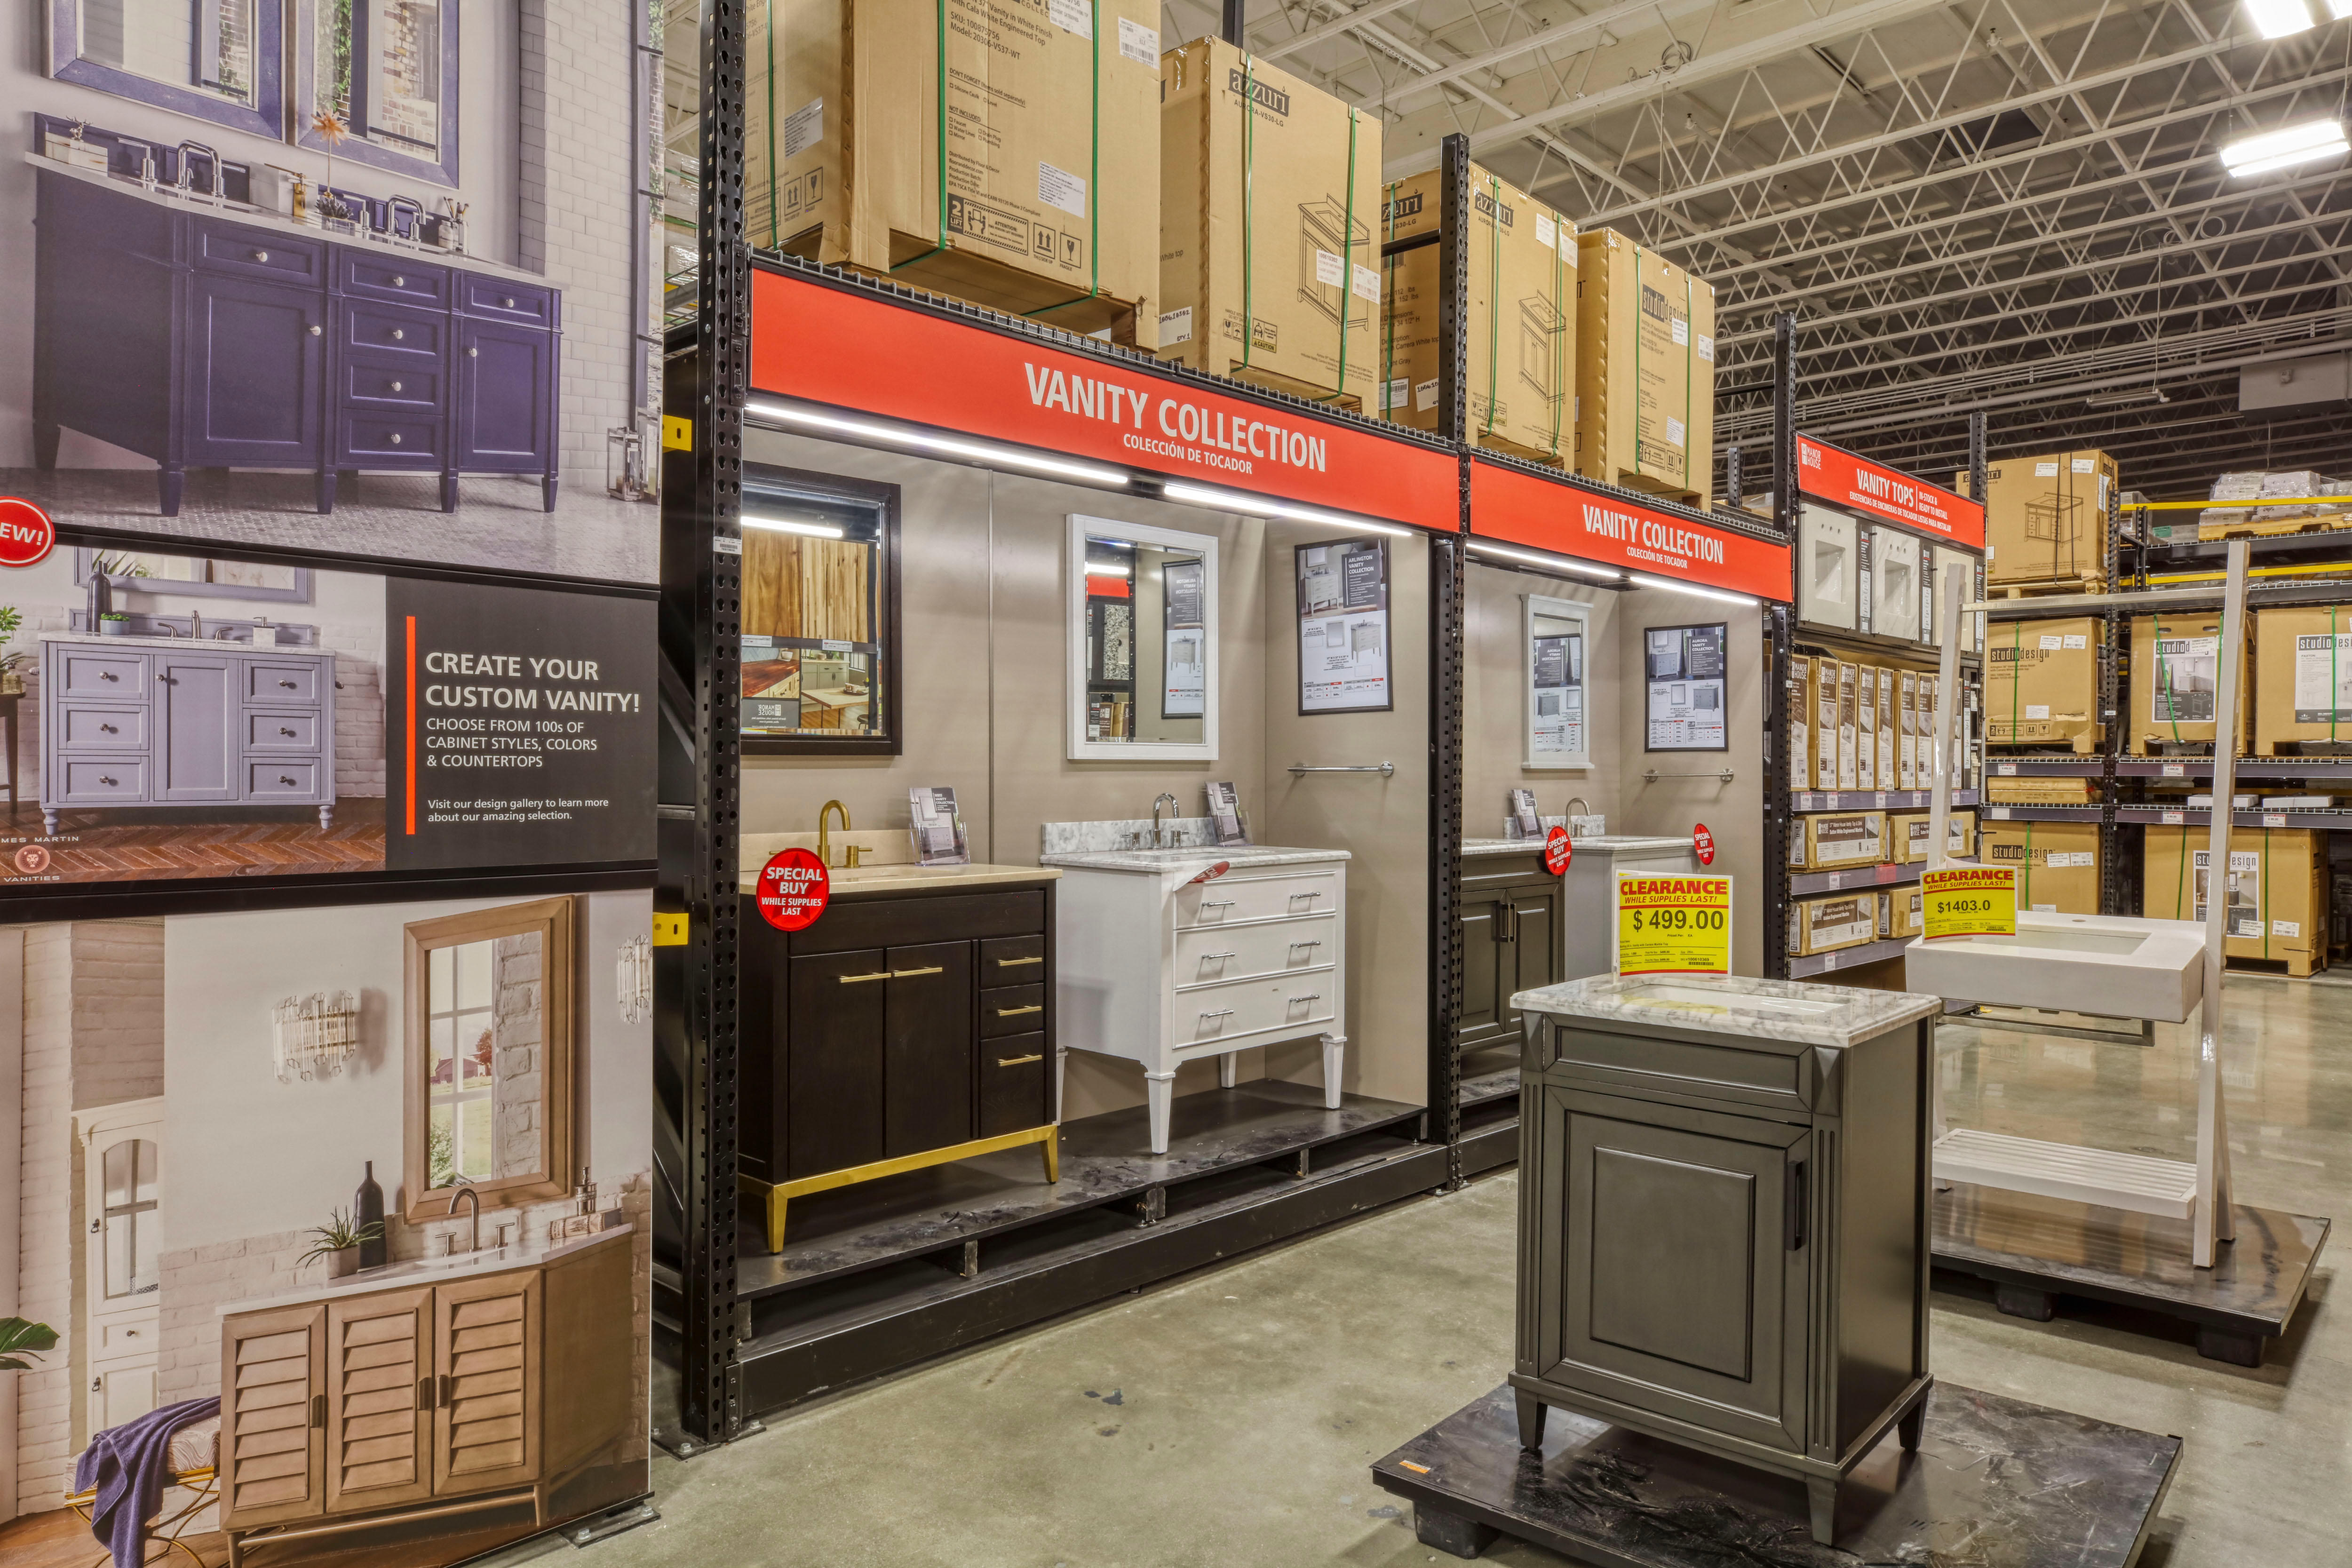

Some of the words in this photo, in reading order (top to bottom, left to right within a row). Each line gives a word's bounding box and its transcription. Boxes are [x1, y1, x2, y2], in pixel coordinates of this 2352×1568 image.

[951, 11, 965, 24] SKU:
[967, 19, 1000, 41] 100875756
[967, 2, 979, 15] Cala
[981, 8, 998, 24] White
[1000, 18, 1033, 40] Engineered
[1034, 34, 1046, 47] Top
[990, 3, 1009, 19] Vanity
[1010, 12, 1016, 21] in
[1017, 15, 1034, 30] White
[1035, 24, 1053, 39] Finish
[951, 22, 972, 38] Model:
[973, 32, 1020, 60] 20306-VS37-WT
[964, 74, 980, 86] FORGET
[949, 104, 959, 114] NOT
[959, 109, 981, 122] INCLUDED
[949, 151, 970, 163] Distributed
[949, 166, 970, 177] Production
[949, 173, 970, 185] Production
[957, 183, 967, 191] TSCA
[988, 193, 998, 202] CARB
[1009, 201, 1020, 210] Phase
[952, 200, 961, 216] 2
[950, 217, 963, 226] LIFT
[1160, 252, 1174, 263] White
[1175, 248, 1184, 258] top
[1059, 263, 1073, 271] FRAGILE
[1257, 341, 1275, 351] CAUTION
[1415, 338, 1430, 346] White
[1025, 362, 1149, 430] VANITY
[1159, 398, 1326, 473] COLLECTION
[1123, 433, 1185, 459] COLECCIÓN
[1187, 447, 1201, 463] DE
[1204, 450, 1252, 475] TOCADOR
[1807, 446, 1821, 461] MANOR
[1807, 454, 1821, 470] HOUSE
[1856, 468, 1890, 500] VANITY
[1892, 481, 1914, 508] TOPS
[1919, 491, 1934, 504] IN-STOCK
[1850, 491, 1872, 506] EXISTENCIAS
[1872, 499, 1877, 508] DE
[1878, 500, 1898, 515] ENCIMERAS
[1898, 506, 1903, 516] DE
[1903, 508, 1918, 521] TOCADOR
[1918, 513, 1928, 525] LISTAS
[1937, 519, 1952, 533] INSTALAR
[1919, 502, 1930, 513] READY
[1930, 506, 1935, 515] TO
[1935, 507, 1948, 520] INSTALL
[0, 522, 44, 546] EW!
[1582, 503, 1638, 543] VANITY
[1642, 520, 1724, 565] COLLECTION
[1348, 555, 1373, 563] ARLINGTON
[1627, 546, 1655, 562] COLECCIÓN
[1656, 554, 1663, 564] DE
[1664, 555, 1688, 569] TOCADOR
[426, 652, 521, 677] CREATE
[529, 657, 599, 681] YOUR
[1795, 662, 1807, 671] MANOR
[1825, 668, 1836, 677] MANOR
[1845, 668, 1855, 676] MANOR
[1795, 671, 1807, 680] HOUSE
[1825, 676, 1836, 685] HOUSE
[425, 685, 537, 709] CUSTOM
[546, 690, 640, 712] VANITY!
[426, 718, 485, 731] CHOOSE
[490, 719, 530, 732] FROM
[535, 721, 563, 733] 100s
[566, 722, 584, 733] OF
[426, 736, 486, 749] CABINET
[492, 738, 542, 752] STYLES,
[546, 739, 597, 751] COLORS
[427, 755, 437, 767] &
[442, 755, 543, 768] COUNTERTOPS
[428, 799, 451, 809] Visit
[474, 799, 507, 811] design
[510, 798, 543, 811] gallery
[545, 799, 556, 808] to
[558, 798, 582, 807] learn
[428, 812, 460, 822] about
[482, 811, 525, 823] amazing
[528, 810, 572, 820] selection.
[1548, 835, 1568, 850] SPECIAL
[1694, 832, 1710, 841] SPECIAL
[1553, 844, 1565, 856] BUY
[1548, 857, 1558, 865] WHILE
[1557, 851, 1571, 861] SUPPLIES
[766, 867, 823, 881] SPECIAL
[1923, 870, 2014, 885] CLEARANCE
[779, 881, 809, 894] BUY
[1621, 880, 1727, 896] CLEARANCE
[1928, 881, 1947, 890] WHILE
[761, 897, 787, 906] WHILE
[787, 898, 822, 907] SUPPLIES
[1625, 896, 1646, 904] WHILE
[1938, 899, 1991, 914] $1403.0
[782, 907, 801, 915] LAST
[1649, 909, 1724, 930] 499.00
